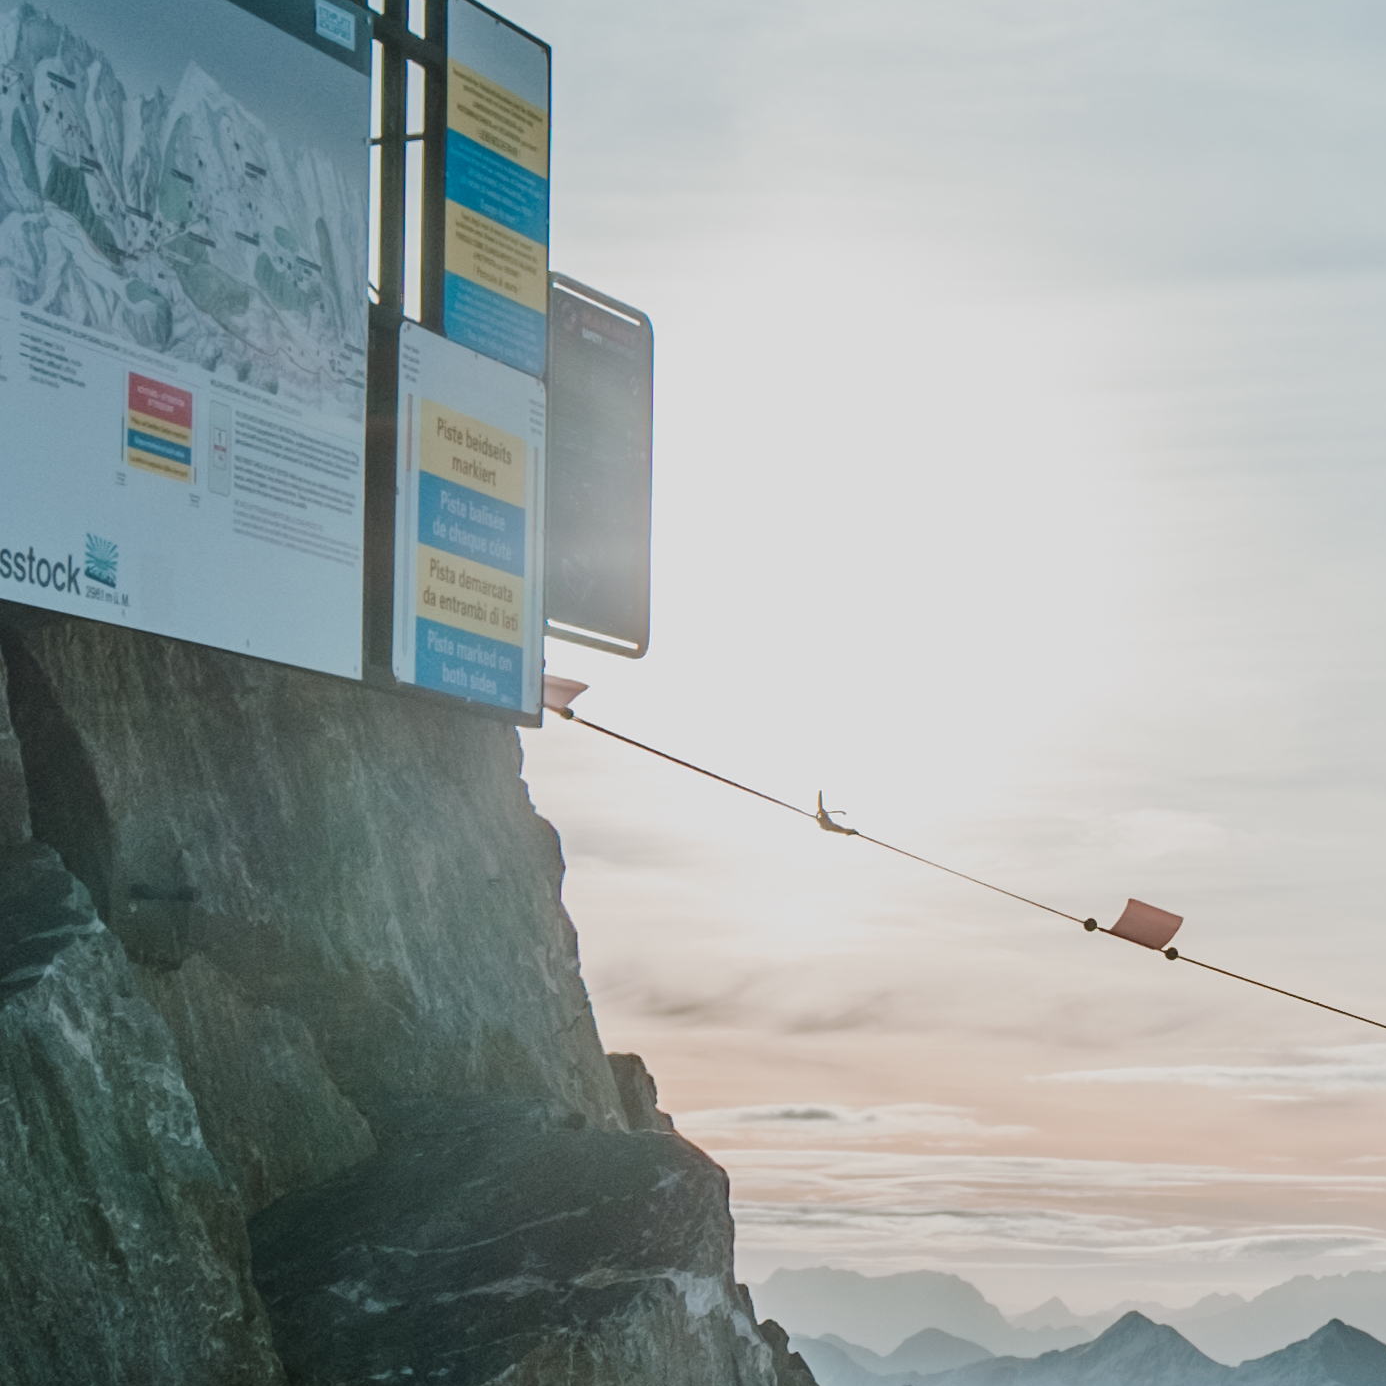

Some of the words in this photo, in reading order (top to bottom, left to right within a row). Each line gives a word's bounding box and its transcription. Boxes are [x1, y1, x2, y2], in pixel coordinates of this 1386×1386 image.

[437, 416, 463, 446] Piste
[465, 428, 512, 466] beidseits
[451, 456, 497, 486] markiert
[440, 489, 467, 518] Piste
[469, 500, 506, 532] balisée
[432, 516, 446, 538] de
[448, 522, 488, 553] chaque
[0, 546, 80, 596] sstock
[429, 558, 456, 585] Pista
[458, 569, 513, 603] demarcata
[423, 585, 437, 606] da
[439, 594, 487, 622] entrambi
[502, 609, 519, 632] lati
[427, 629, 454, 655] Piste
[457, 642, 497, 670] marked
[499, 656, 512, 672] on
[442, 662, 467, 687] both
[470, 670, 498, 695] sides
